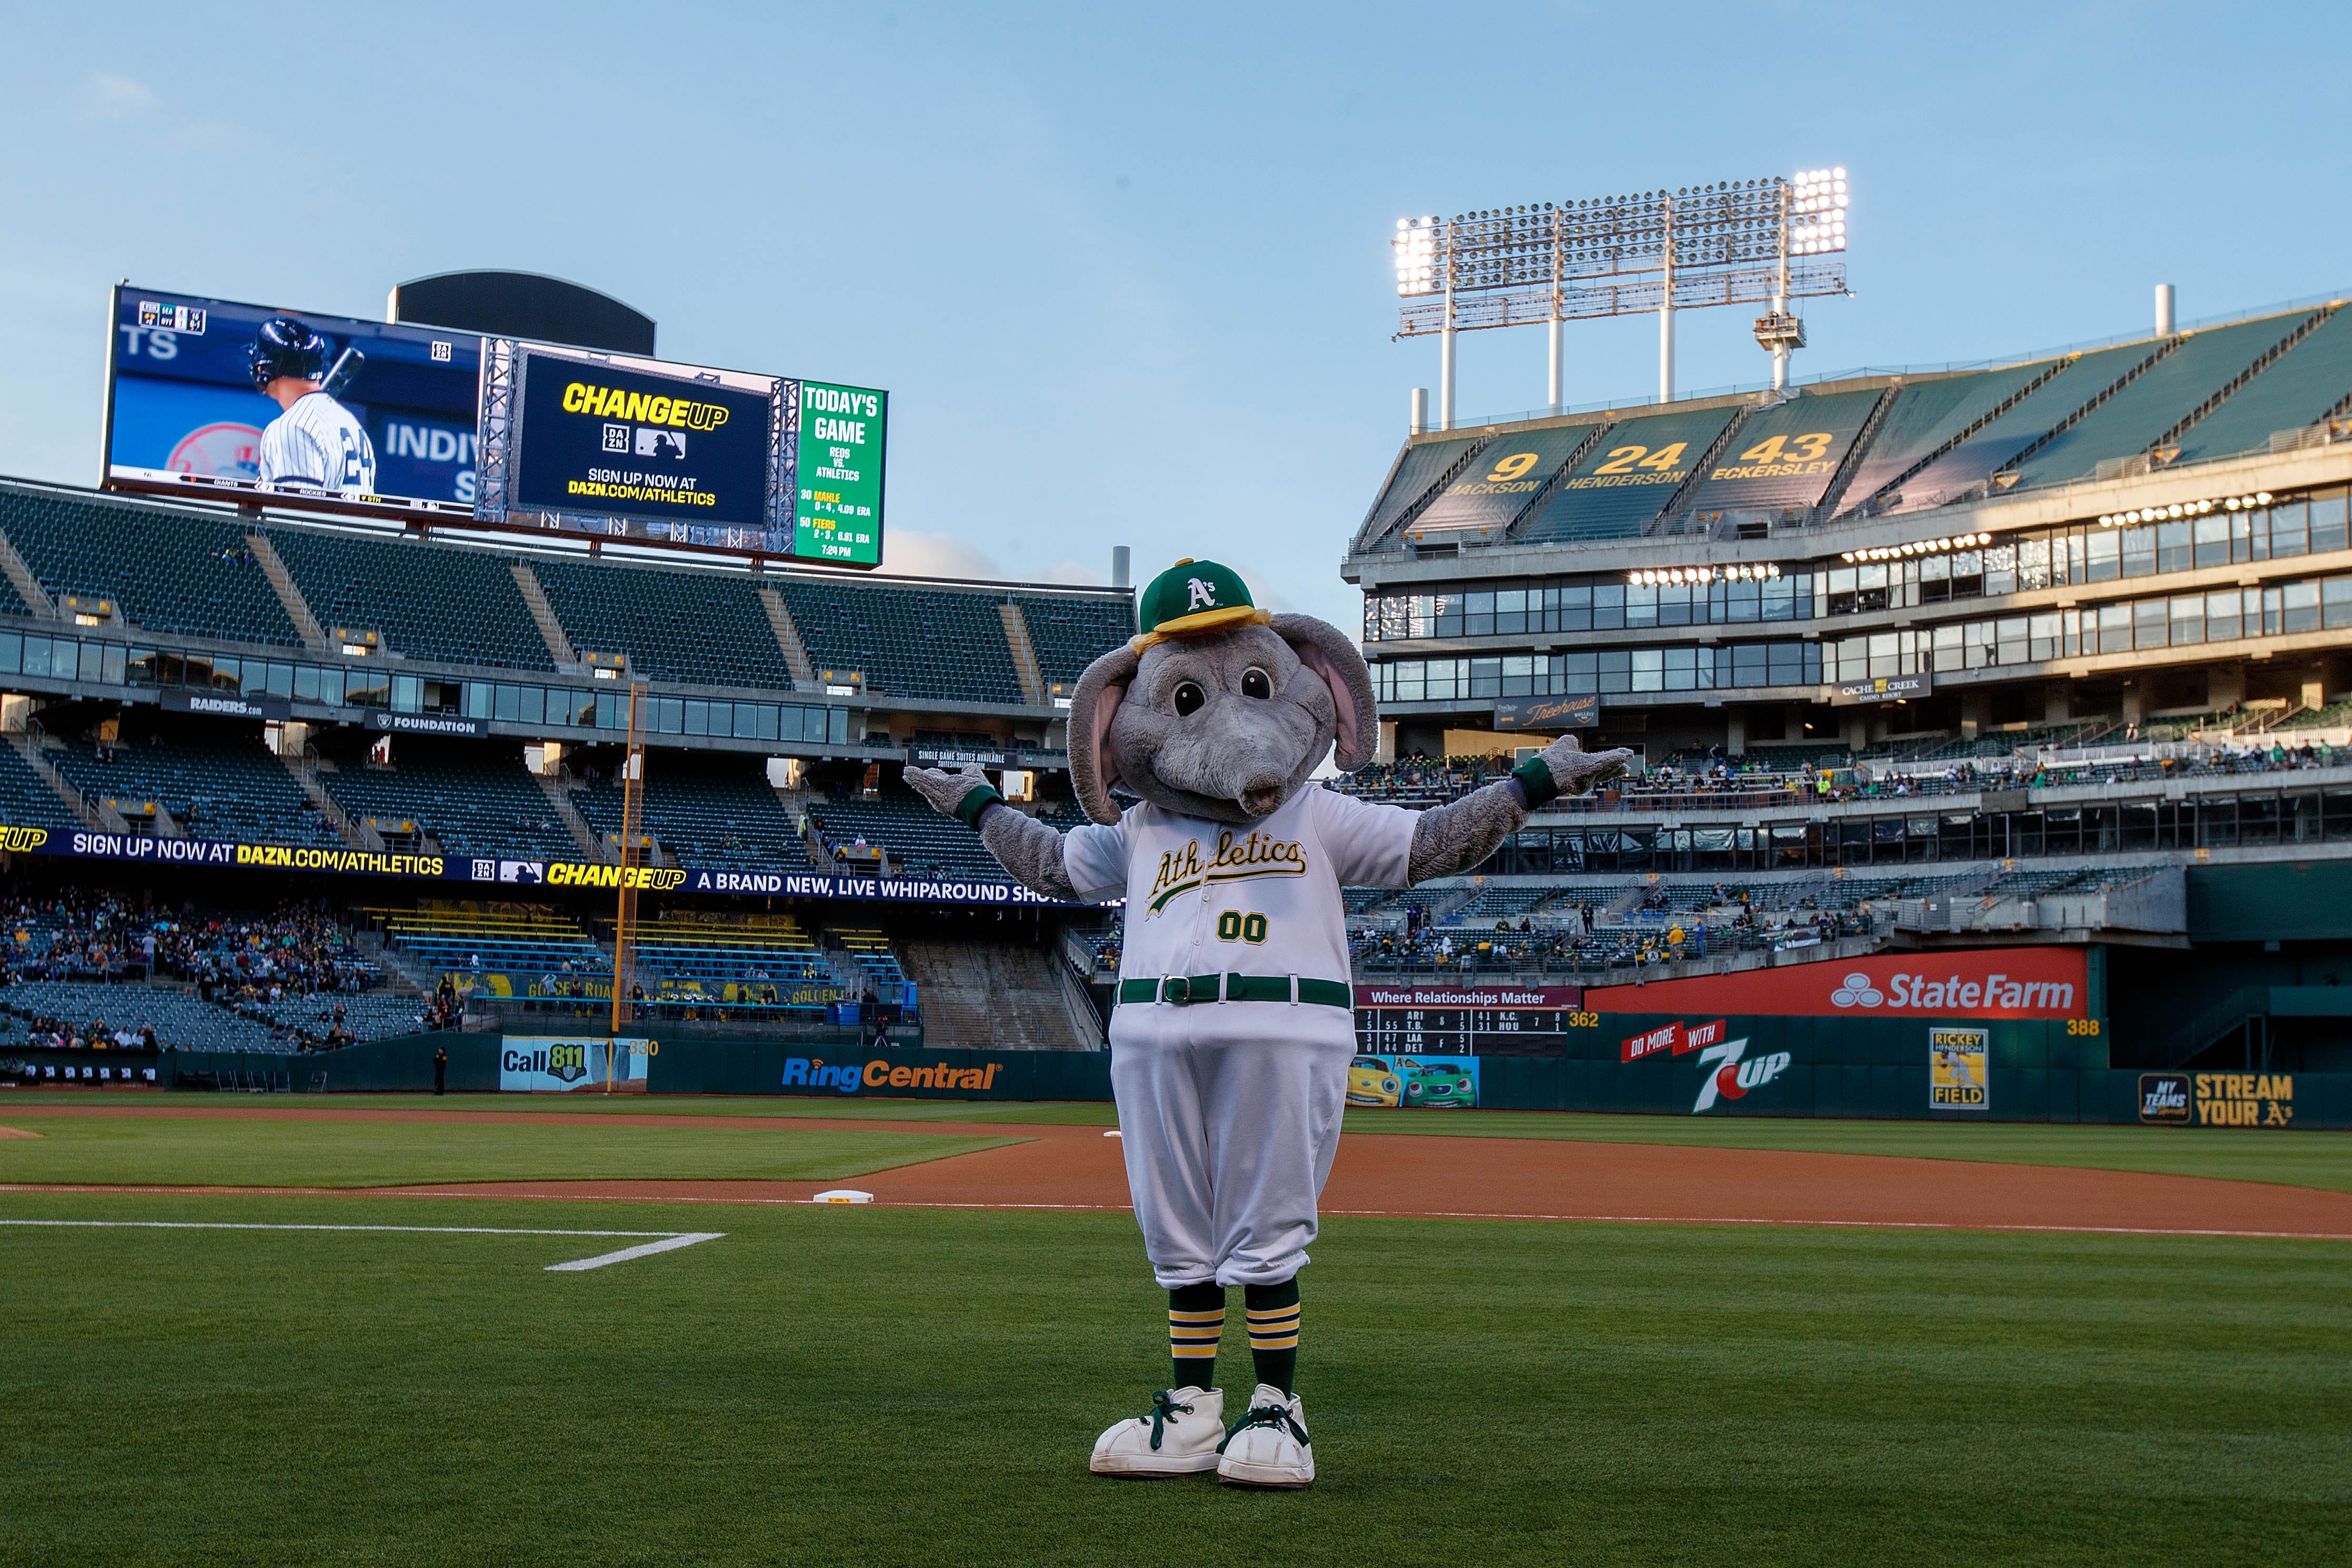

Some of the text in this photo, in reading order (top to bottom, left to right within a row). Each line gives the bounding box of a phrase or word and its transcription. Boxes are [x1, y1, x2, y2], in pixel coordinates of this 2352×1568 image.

[562, 382, 729, 431] CHANGEUP
[804, 386, 878, 417] TODAY'S
[815, 417, 866, 445] GAME
[829, 446, 851, 459] REDS
[1740, 432, 1833, 465] 43
[1592, 441, 1688, 475] 24
[816, 466, 860, 482] ATHLETICS
[1486, 453, 1539, 482] 9
[1710, 459, 1837, 481] ECKERSLEY
[214, 479, 238, 488] GIANTS
[588, 468, 697, 490] SIGN UP NOW AT
[1564, 470, 1686, 490] HENDERSON
[299, 488, 327, 497] ROCKIES
[568, 480, 716, 506] DAZN.COM/ATHLETICS
[800, 489, 840, 504] 30 MAHLE
[1444, 480, 1541, 498] JACKSON
[837, 504, 855, 515] 4.09
[857, 506, 871, 517] ERA
[799, 516, 836, 530] 50 FIERS
[837, 531, 853, 542] 6.81
[856, 534, 870, 544] ERA
[821, 544, 851, 557] 7:24 PM
[1188, 578, 1215, 611] A's
[1842, 679, 1919, 696] CACHE CREEK
[1522, 696, 1596, 726] Treehouse
[394, 717, 476, 733] FOUNDATION
[918, 750, 1005, 763] SINGLE GAME SUITES AVAILABLE
[73, 833, 444, 876] SIGN UP NOW AT DAZN.COM/ATHLETICS
[1147, 828, 1308, 902] Athletics
[546, 862, 687, 890] CHANGEUP
[697, 872, 711, 889] A
[716, 874, 781, 892] BRAND
[786, 876, 834, 898] NEW,
[838, 879, 876, 896] LIVE
[880, 880, 1009, 901] WHIPAROUND
[1216, 909, 1269, 944] 00
[585, 982, 615, 1000] ROA
[1371, 991, 1545, 1007] Where Relationships Matter
[1407, 1011, 1424, 1020] ARI
[1440, 1016, 1445, 1026] 8
[1460, 1011, 1464, 1021] 1
[1500, 1012, 1518, 1021] K.C.
[1534, 1017, 1540, 1027] 7
[1555, 1012, 1560, 1021] 8
[1569, 1011, 1599, 1028] 362
[1367, 1021, 1372, 1030] 5
[1406, 1021, 1424, 1031] T.B.
[1460, 1022, 1465, 1031] 5
[1499, 1022, 1519, 1031] HOU
[1555, 1022, 1560, 1032] 1
[2066, 1019, 2100, 1037] 388
[1366, 1033, 1372, 1042] 3
[1406, 1034, 1422, 1043] LAA
[1439, 1038, 1444, 1049] F
[1460, 1034, 1465, 1044] 5
[1631, 1024, 1716, 1058] DO MORE WITH
[1935, 1033, 1982, 1046] RICKEY
[628, 1040, 659, 1057] 330
[1405, 1043, 1424, 1053] DET
[1460, 1045, 1465, 1054] 2
[503, 1045, 585, 1072] Call 811
[1693, 1037, 1791, 1114] 7 UP
[2156, 1081, 2177, 1094] MY
[2195, 1073, 2293, 1101] STREAM
[1935, 1088, 1983, 1103] FIELD
[2145, 1093, 2187, 1108] TEAMS
[2195, 1100, 2259, 1126] YOUR
